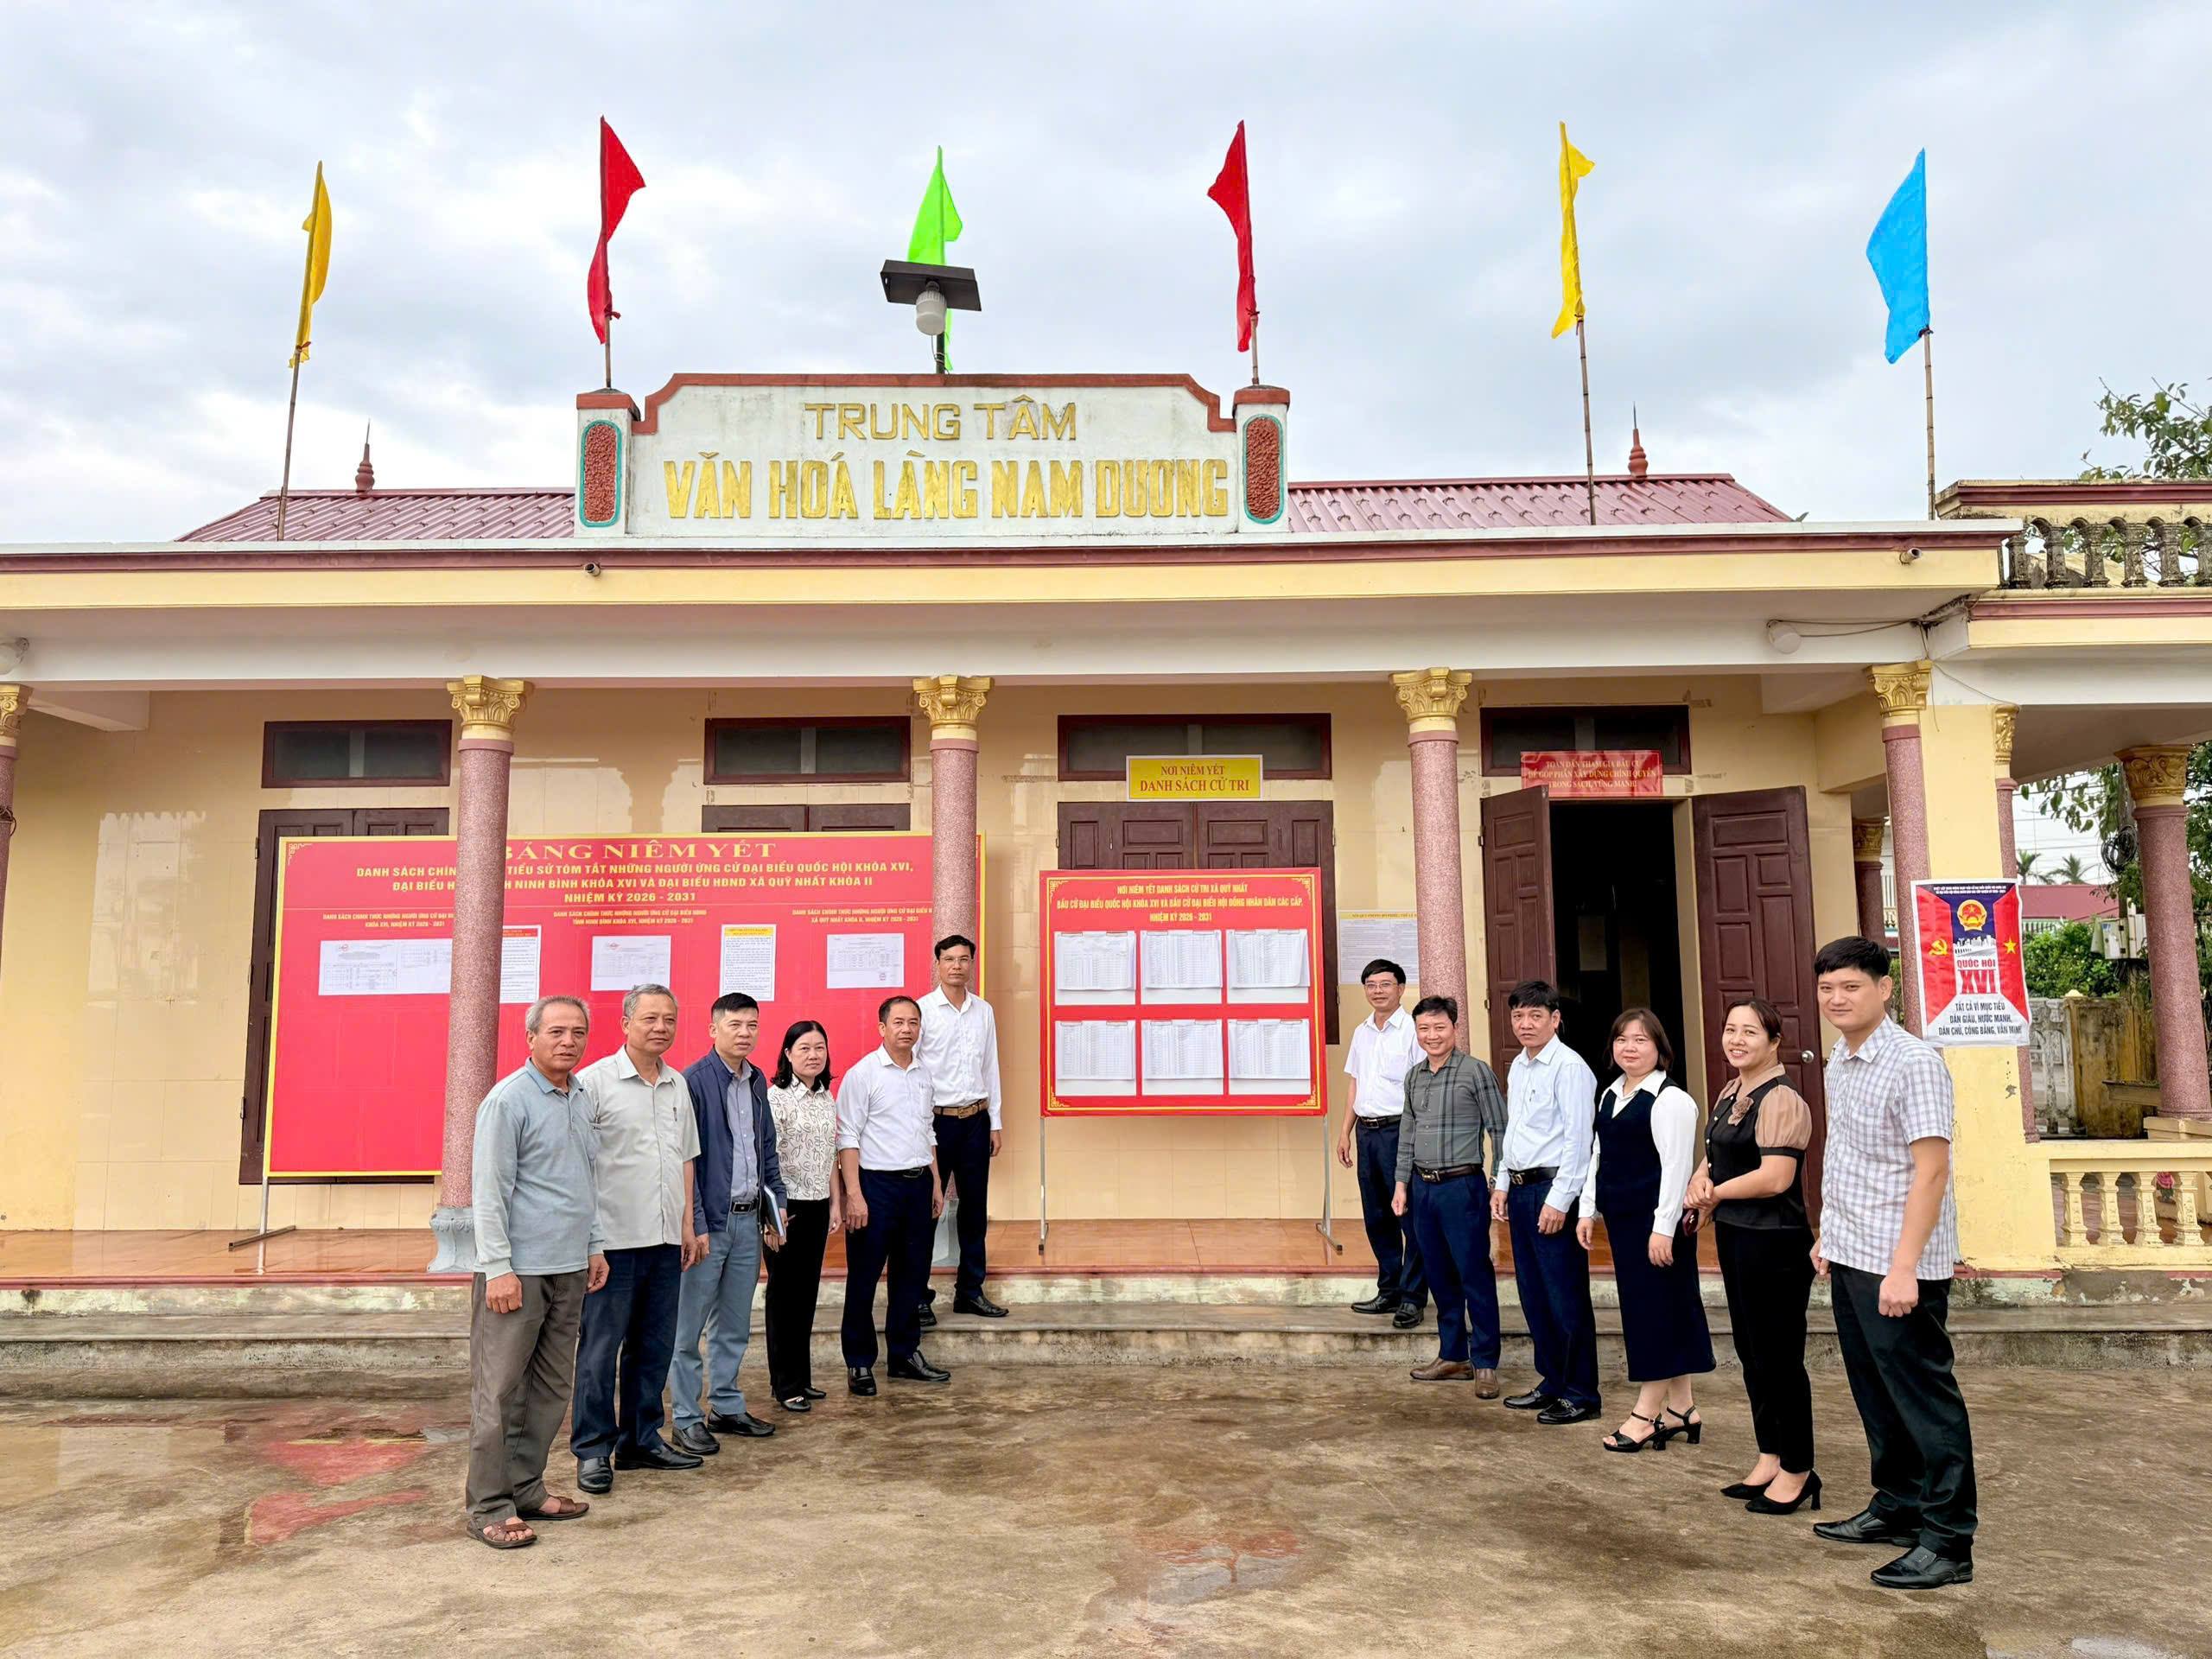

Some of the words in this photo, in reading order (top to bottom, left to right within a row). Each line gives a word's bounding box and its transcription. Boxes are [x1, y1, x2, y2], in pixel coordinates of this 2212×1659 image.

[804, 402, 961, 441] TRUNG
[973, 394, 1077, 441] TÂM
[663, 451, 752, 519] VĂN
[768, 451, 859, 519] HOÁ
[873, 449, 979, 520] LÀNG
[991, 460, 1084, 518] NAM
[1160, 765, 1178, 776] NƠI
[1180, 763, 1205, 776] NIÊM
[1207, 763, 1225, 776] YẾT
[1140, 779, 1173, 791] DANH
[1175, 777, 1206, 791] SÁCH
[1210, 777, 1228, 791] CỬ
[1229, 779, 1249, 791] TRI
[602, 839, 698, 860] NIÊM
[706, 838, 776, 858] YẾT
[356, 867, 389, 877] DANH
[393, 865, 425, 876] SÁCH
[428, 865, 456, 876] CHÍN
[507, 862, 533, 875] TIỂU
[537, 862, 554, 875] SỬ
[556, 864, 582, 874] TÓM
[609, 863, 652, 874] NHỮNG
[655, 862, 692, 874] NGƯỜI
[696, 862, 721, 874] ỨNG
[723, 861, 743, 873] CỬ
[743, 863, 763, 874] ĐẠI
[766, 861, 794, 873] BIỂU
[797, 861, 829, 873] QUỐC
[832, 862, 852, 874] HỘI
[855, 861, 887, 872] KHÓA
[392, 881, 413, 893] ĐẠI
[416, 878, 444, 891] BIỂU
[514, 880, 545, 889] NINH
[549, 878, 578, 889] BÌNH
[582, 878, 613, 888] KHÓA
[617, 879, 637, 888] XVI
[639, 877, 655, 888] VÀ
[658, 877, 679, 889] ĐẠI
[682, 874, 710, 887] BIỂU
[713, 877, 747, 887] HĐND
[749, 876, 765, 887] XÃ
[795, 874, 826, 886] NHẤT
[829, 875, 861, 886] KHÓA
[864, 876, 873, 886] II
[1157, 884, 1173, 893] DANH
[1173, 882, 1190, 893] SÁCH
[564, 892, 604, 904] NHIỆM
[607, 891, 623, 902] KỲ
[626, 893, 656, 902] 2026
[667, 892, 696, 901] 2031
[1960, 969, 1997, 994] XVI
